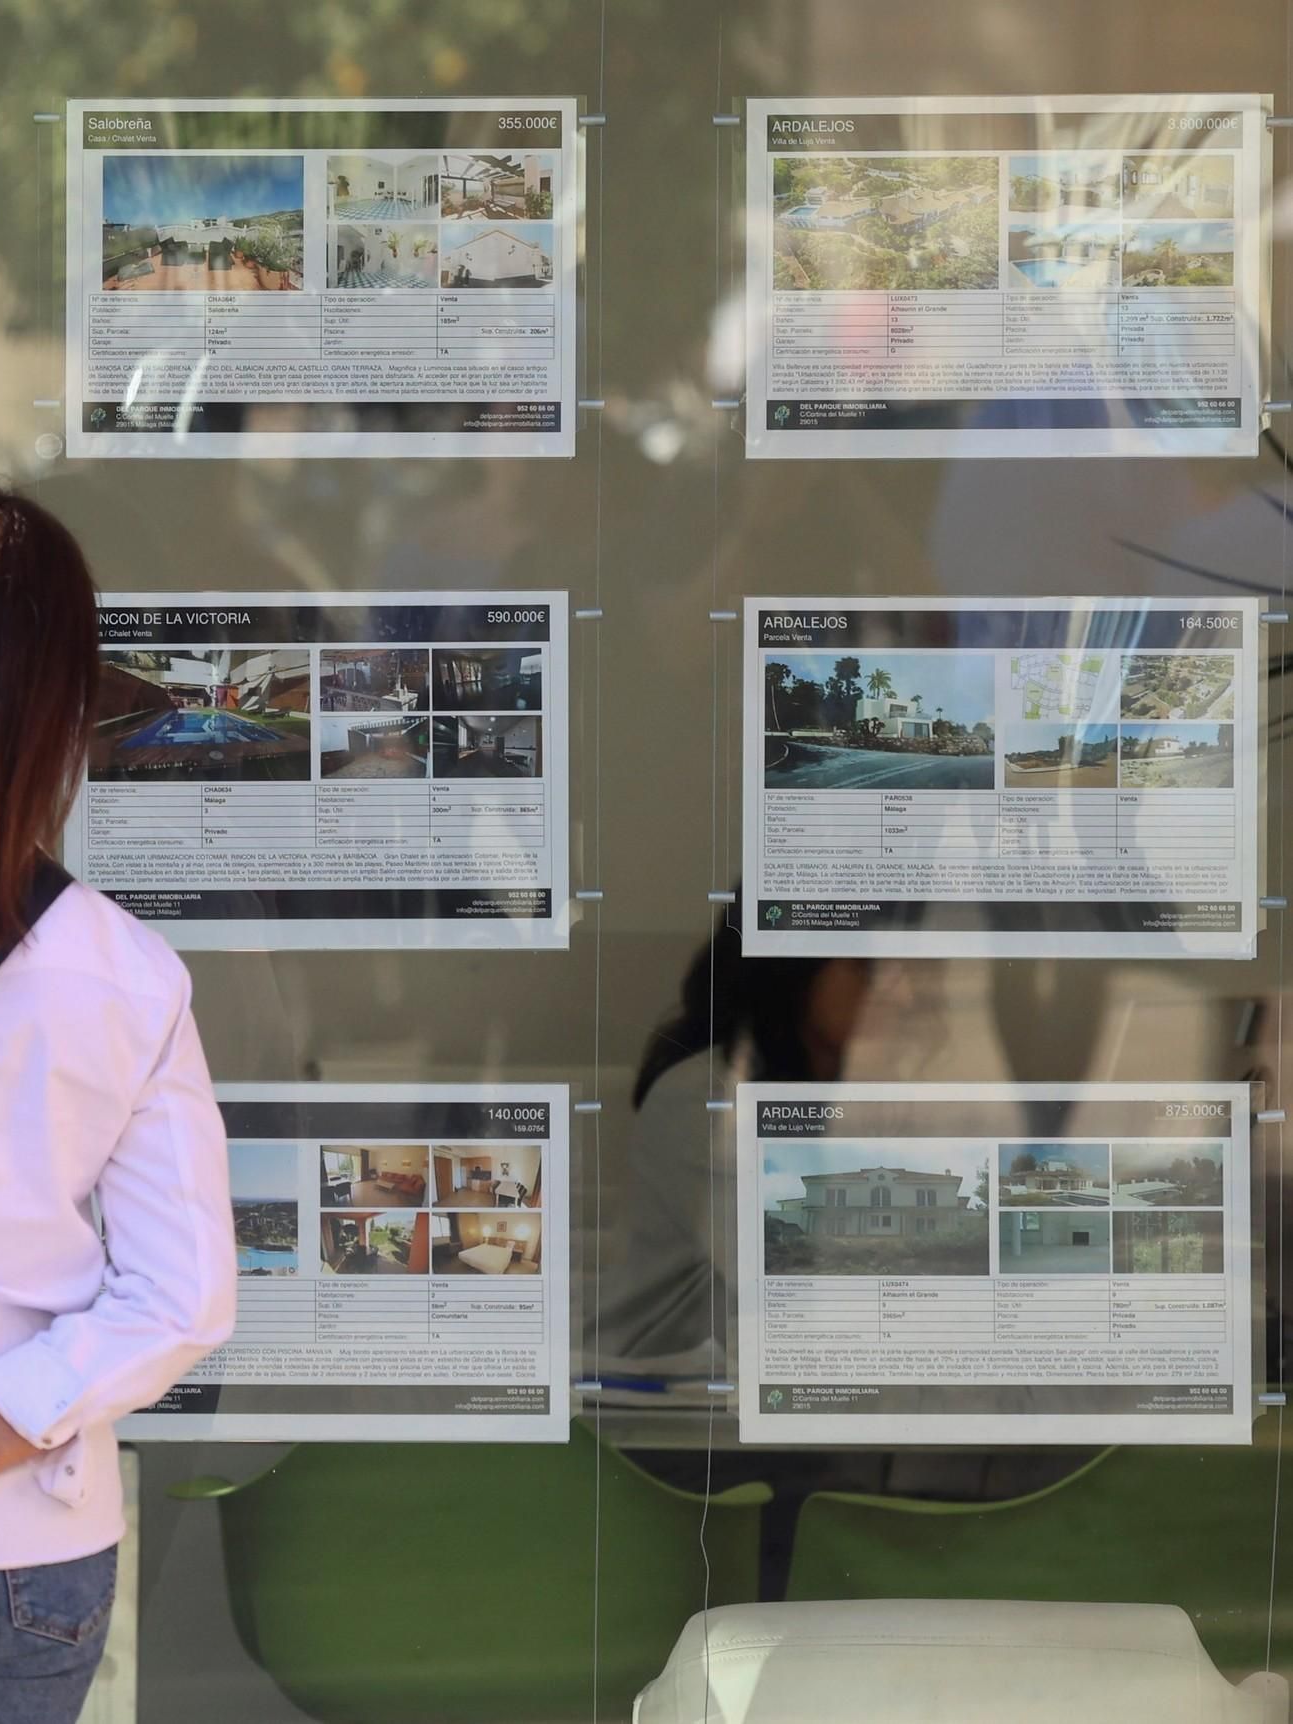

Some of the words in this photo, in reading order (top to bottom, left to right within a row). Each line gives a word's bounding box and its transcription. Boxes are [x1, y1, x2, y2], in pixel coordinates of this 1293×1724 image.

[88, 117, 152, 130] Salobreña
[498, 117, 557, 129] 355.000€
[772, 120, 855, 132] ARDALEJOS
[1167, 117, 1238, 130] 3.600.000€
[87, 134, 107, 142] Casa
[111, 134, 135, 142] Chalet
[772, 137, 787, 145] Villa
[788, 137, 798, 145] de
[798, 137, 814, 146] Lujo
[815, 137, 835, 145] Venta
[814, 403, 842, 411] PARQUE
[142, 613, 163, 625] DE
[165, 613, 184, 624] LA
[185, 612, 251, 625] VICTORIA
[487, 611, 545, 623] 590.000€
[763, 616, 848, 628] ARDALEJOS
[1178, 617, 1238, 629] 164.500€
[763, 633, 790, 641] Parcela
[791, 633, 812, 641] Venta
[204, 796, 226, 805] Málaga
[129, 893, 157, 902] PARQUE
[806, 904, 834, 912] PARQUE
[487, 1108, 545, 1120] 140.000€
[761, 1106, 845, 1119] ARDALEJOS
[1165, 1104, 1225, 1117] 875.000€
[761, 1123, 777, 1131] Villa
[778, 1123, 787, 1131] de
[788, 1123, 804, 1132] Lujo
[804, 1123, 825, 1131] Venta
[806, 1388, 834, 1396] PARQUE
